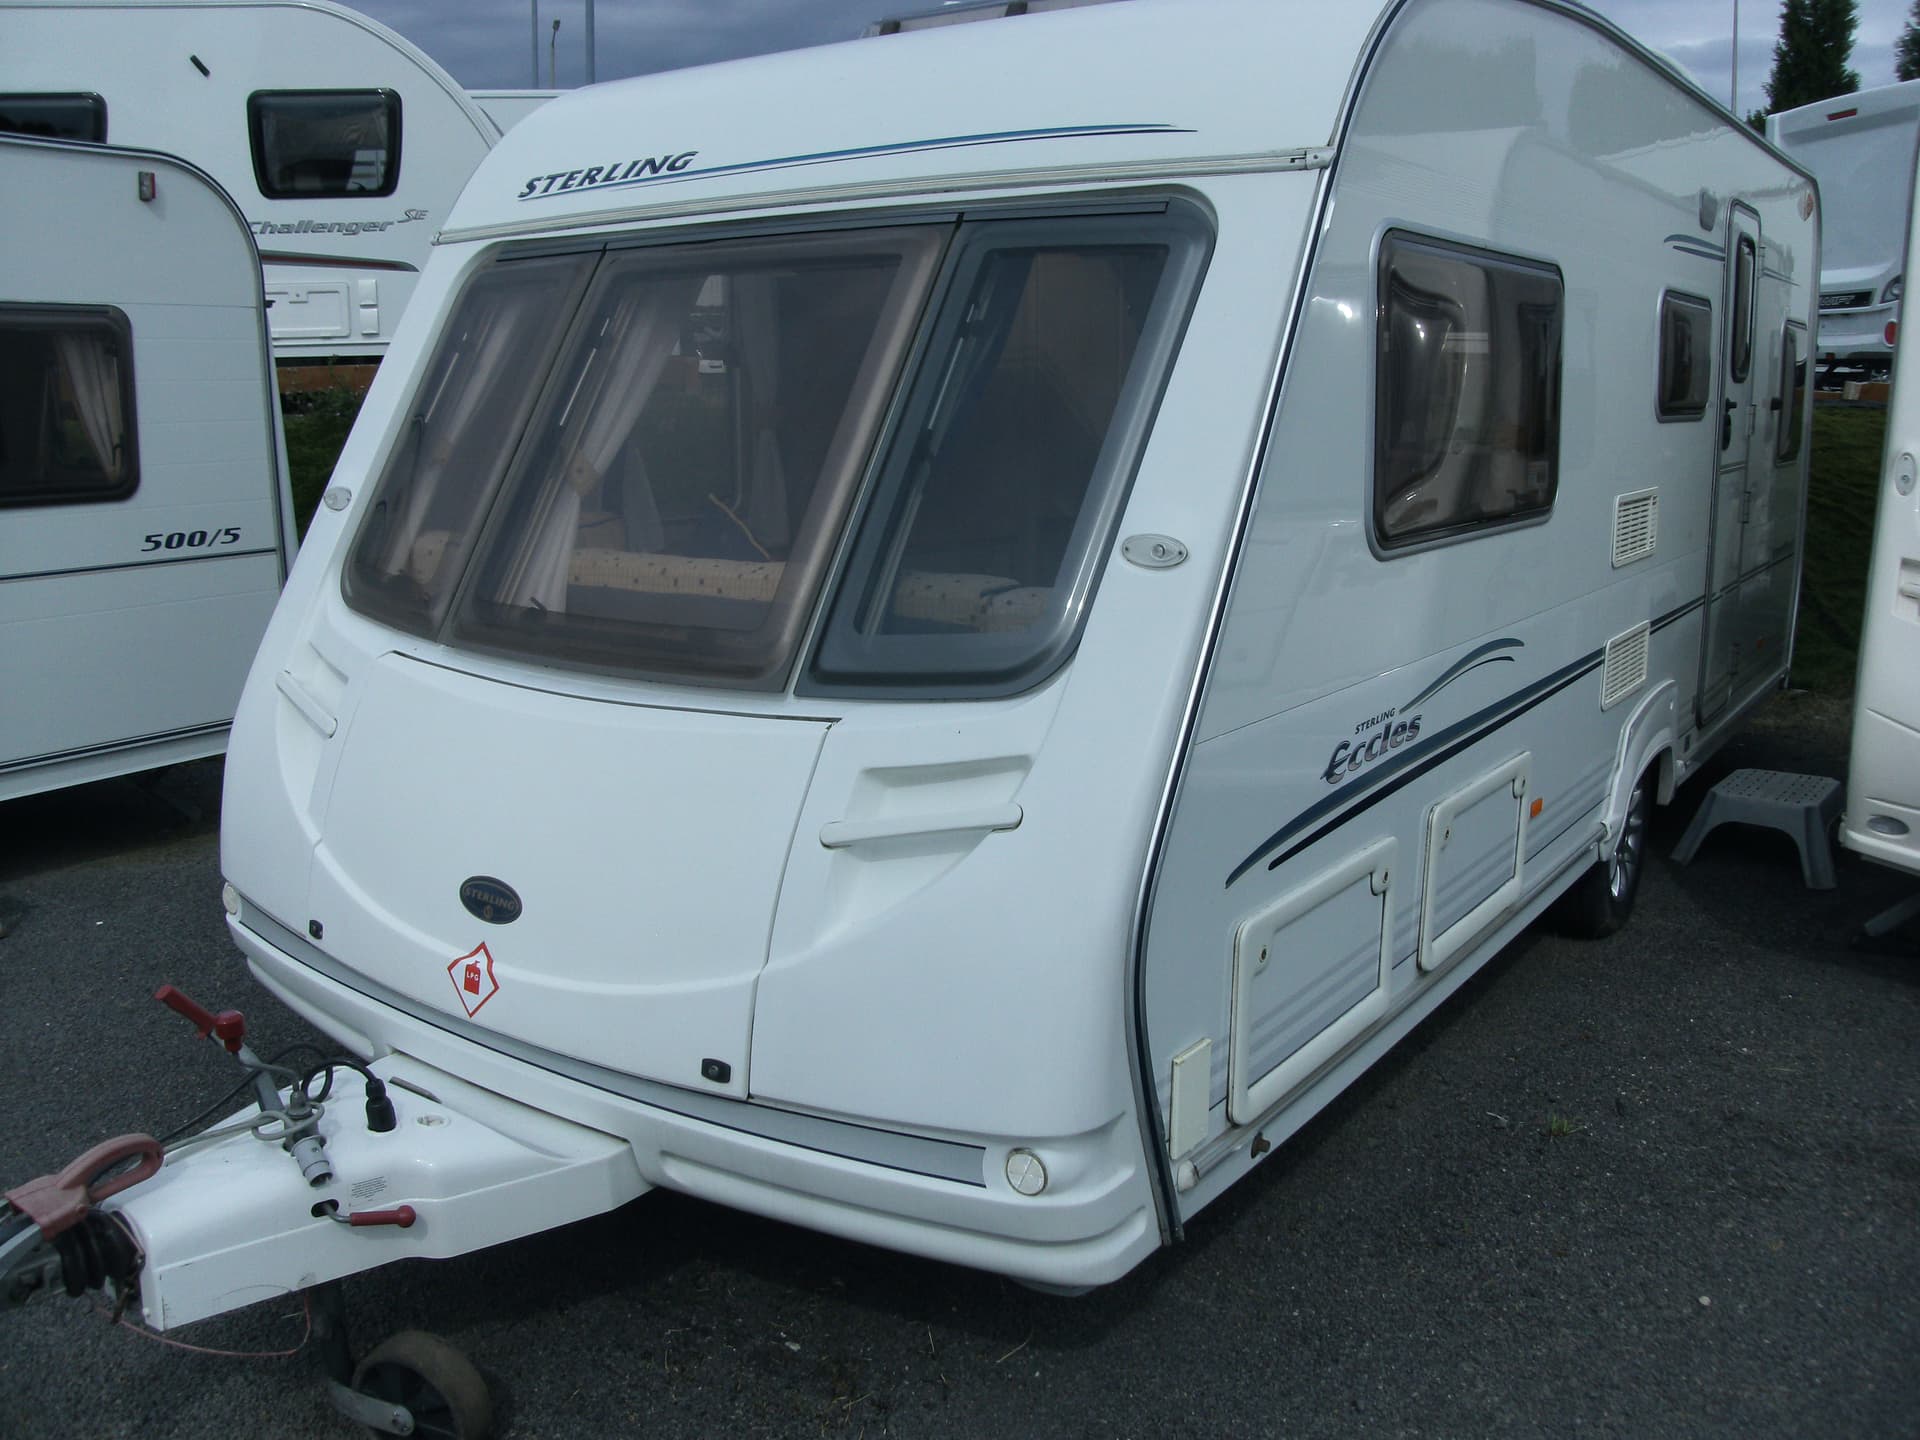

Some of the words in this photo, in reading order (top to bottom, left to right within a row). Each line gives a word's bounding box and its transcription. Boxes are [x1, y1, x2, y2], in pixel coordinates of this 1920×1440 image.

[517, 151, 699, 198] STERLING
[397, 208, 429, 223] SE
[140, 527, 242, 552] 500/5
[1354, 707, 1395, 735] STERLING
[1319, 714, 1423, 785] Eccles
[464, 886, 515, 911] STERLING
[466, 971, 479, 981] LPG
